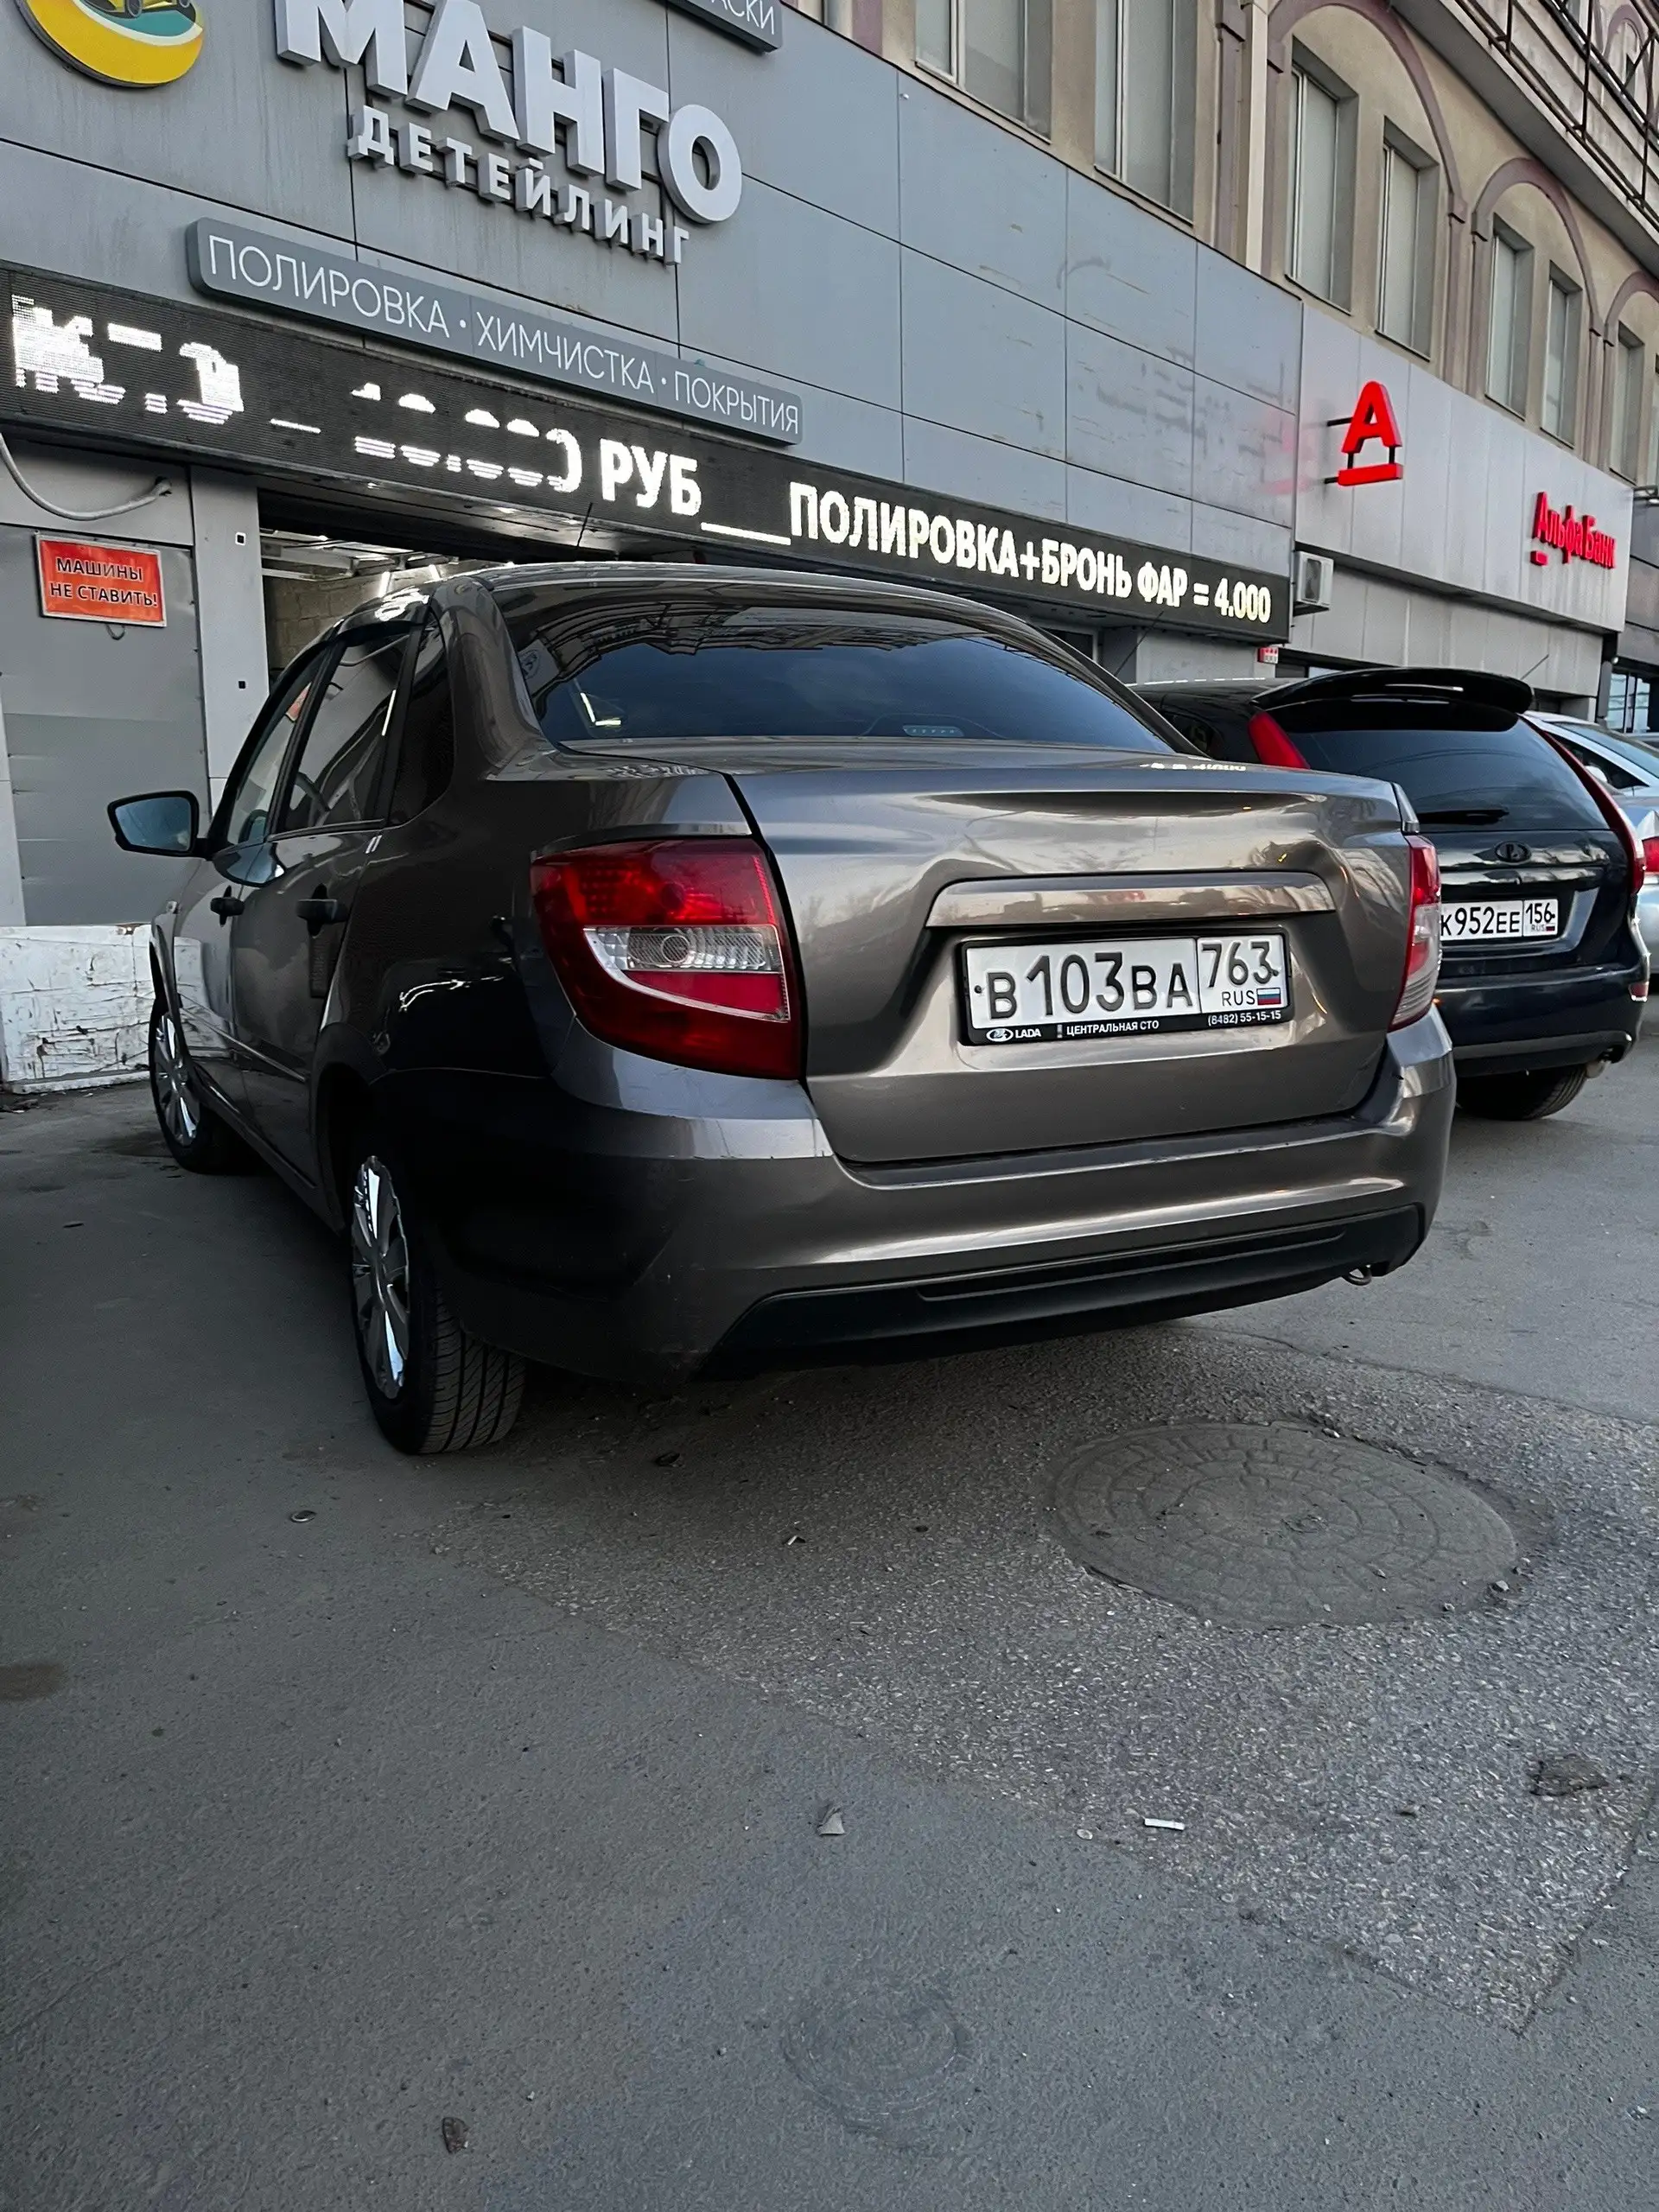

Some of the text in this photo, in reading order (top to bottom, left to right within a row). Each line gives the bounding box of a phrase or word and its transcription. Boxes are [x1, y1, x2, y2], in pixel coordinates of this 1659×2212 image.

[276, 0, 742, 224] МАНГО
[348, 105, 690, 265] ДЕТЕЙЛИНГ
[209, 234, 798, 435] ПОЛИРОВКА ХИМЧИСТКА ПОКРЫТИЯ
[600, 437, 702, 516] РУБ
[57, 557, 143, 582] МАШИНЫ
[1137, 561, 1187, 608] ФАР
[1214, 578, 1272, 623] 4.000
[50, 582, 158, 607] НЕ СТАВИТЬ!
[1526, 902, 1553, 925] 156
[987, 940, 1273, 1020] В103ВА 763
[1221, 989, 1256, 1007] RUS
[1014, 1027, 1042, 1039] LADA
[1065, 1009, 1282, 1037] ЦЕНТРАЛЬНАЯ СТО (8482) 55-15-15
